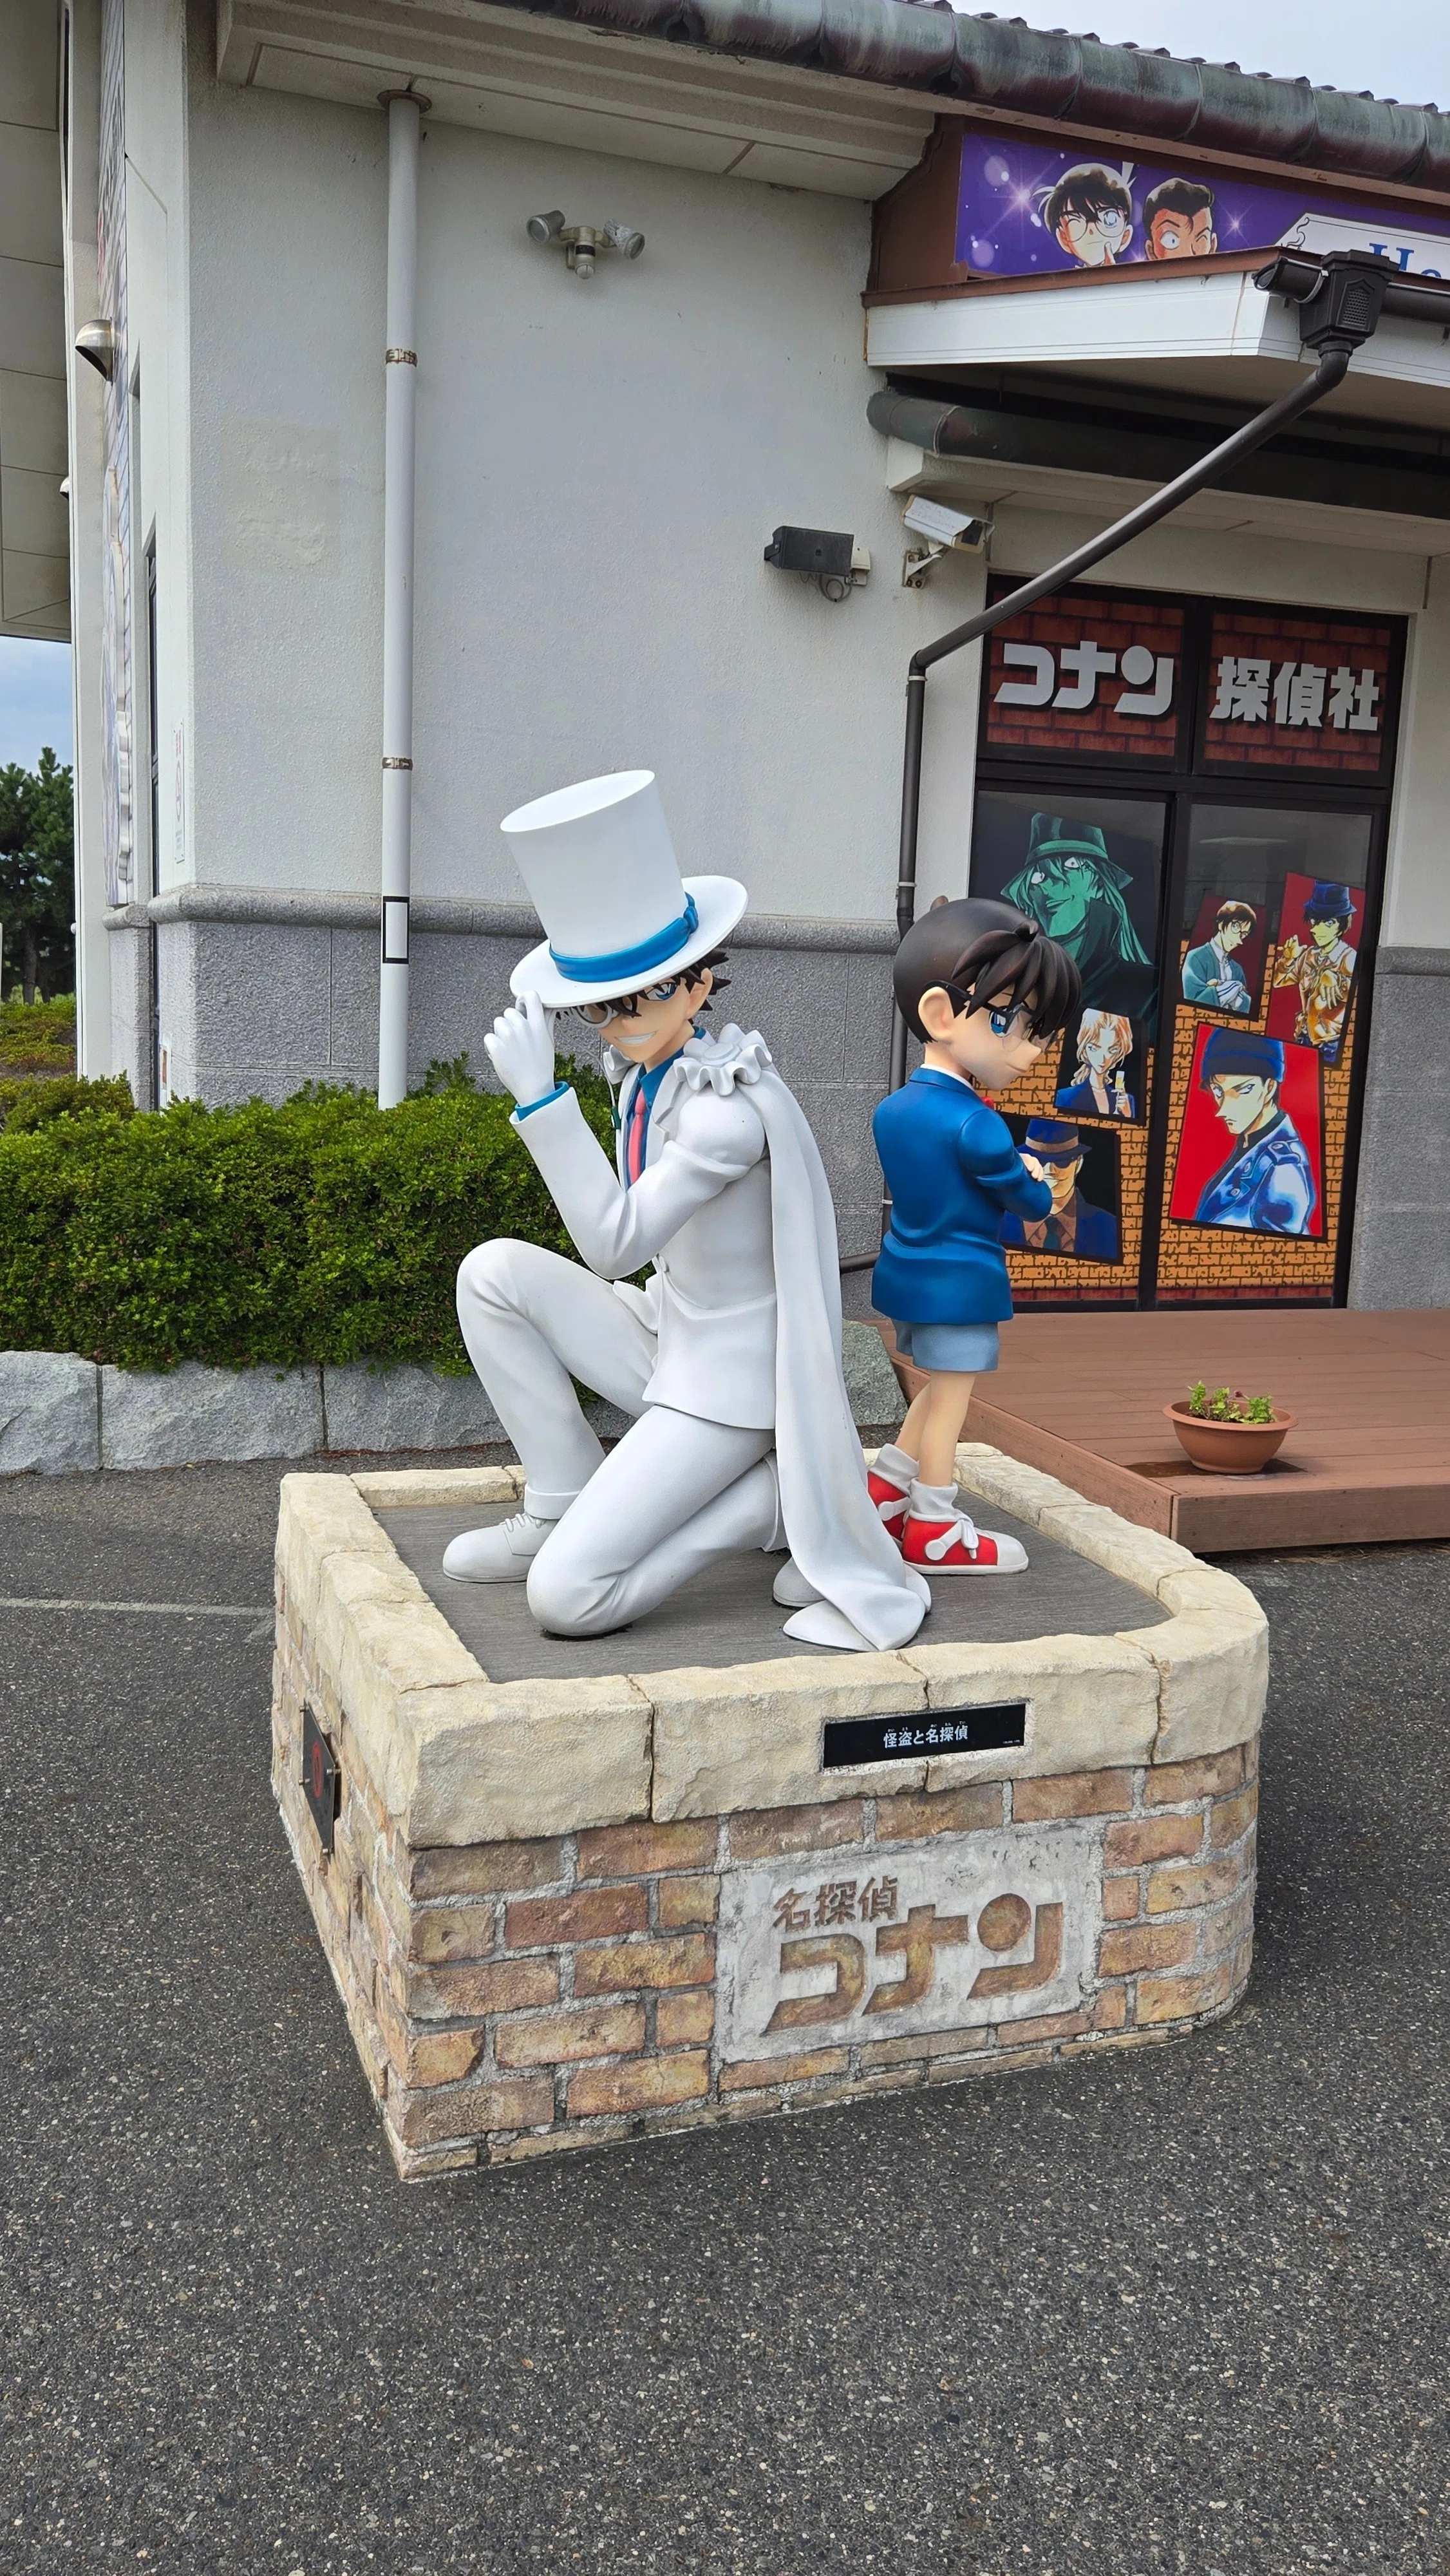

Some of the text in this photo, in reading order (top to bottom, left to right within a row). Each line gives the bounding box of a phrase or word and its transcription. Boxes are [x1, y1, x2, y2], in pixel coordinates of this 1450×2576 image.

[993, 640, 1380, 732] コナン 探偵社
[883, 1725, 968, 1748] 怪盗と名探偵
[773, 1875, 899, 1933] 名探偵
[760, 1892, 1064, 2036] コナン
